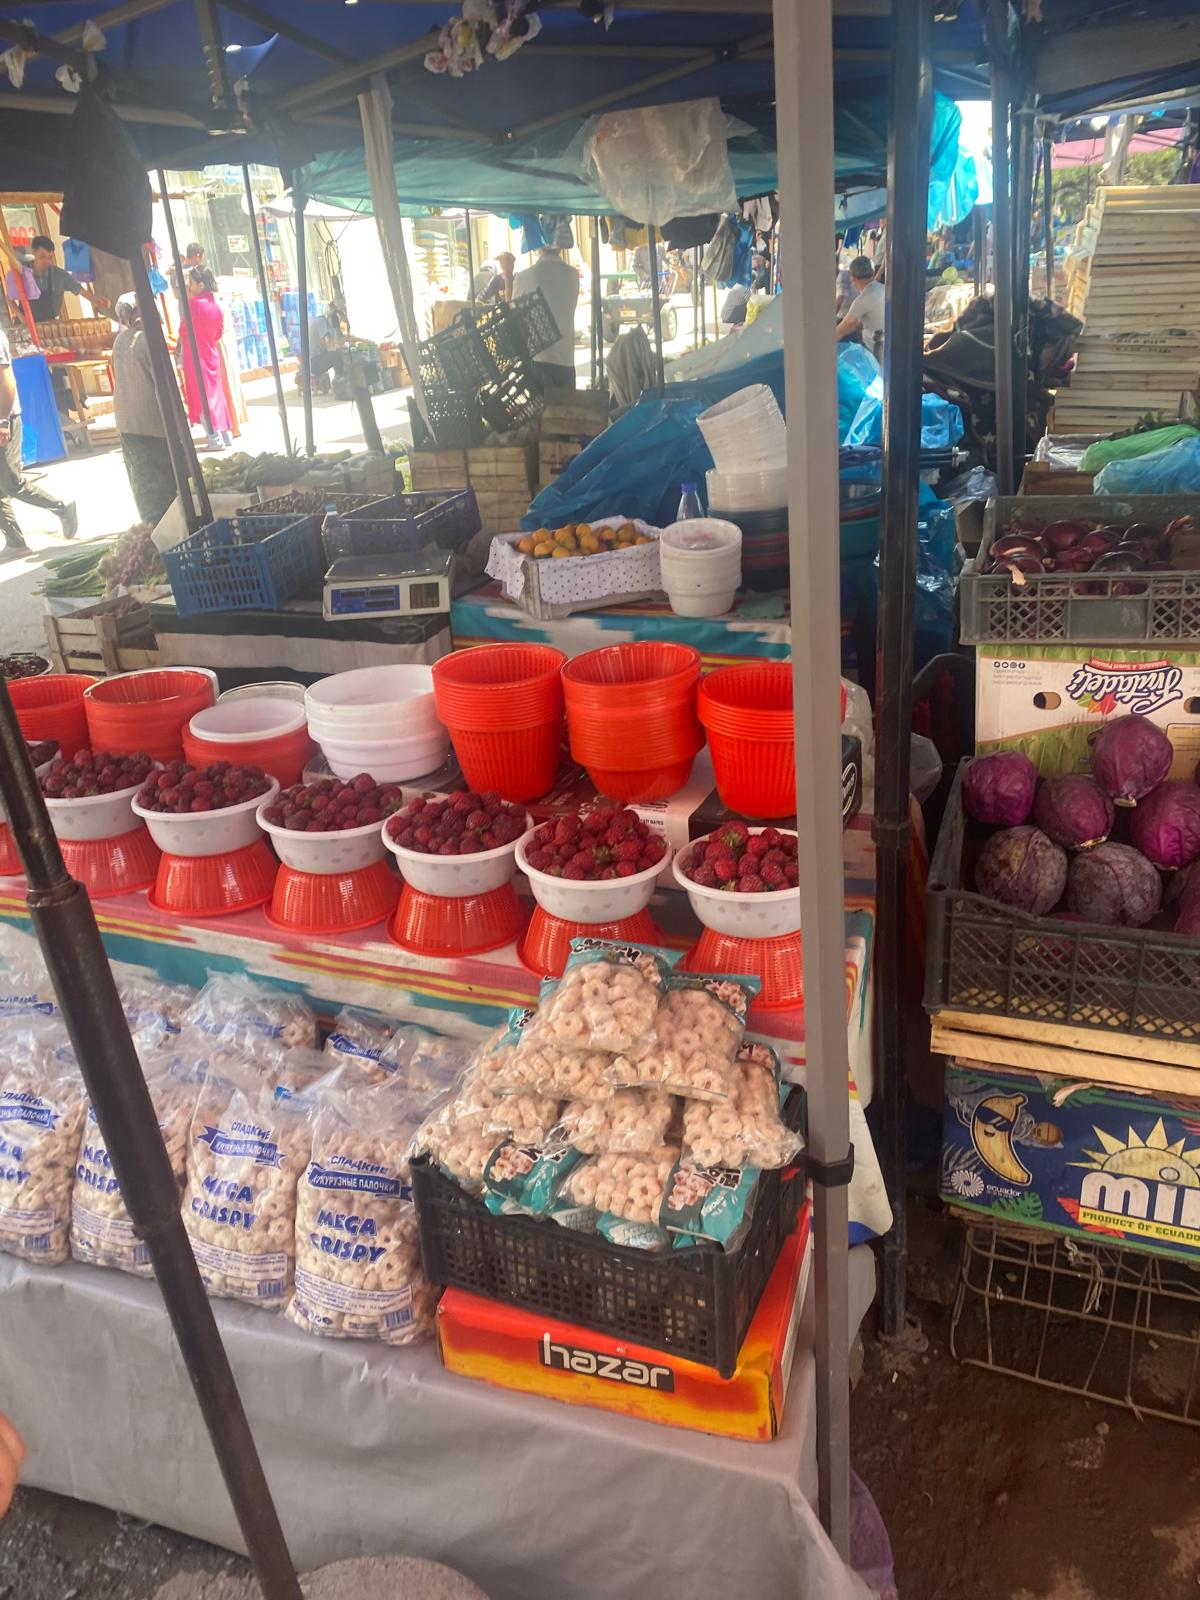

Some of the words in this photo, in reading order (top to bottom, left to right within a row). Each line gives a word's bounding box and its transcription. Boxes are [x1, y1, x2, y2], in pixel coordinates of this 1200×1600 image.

[1066, 667, 1183, 715] Frutadeli
[231, 1122, 272, 1139] СЛАДКИЕ
[330, 1156, 389, 1174] СЛАДКИЕ
[358, 1179, 395, 1192] ПАЛОЧКИ
[986, 1184, 1022, 1197] ecuador
[191, 1196, 257, 1231] CRISPY
[317, 1209, 377, 1236] MEGA
[1082, 1211, 1135, 1228] PRODUCT
[1137, 1221, 1153, 1232] OF
[310, 1232, 387, 1265] CRISPY
[543, 1331, 670, 1388] hazar
